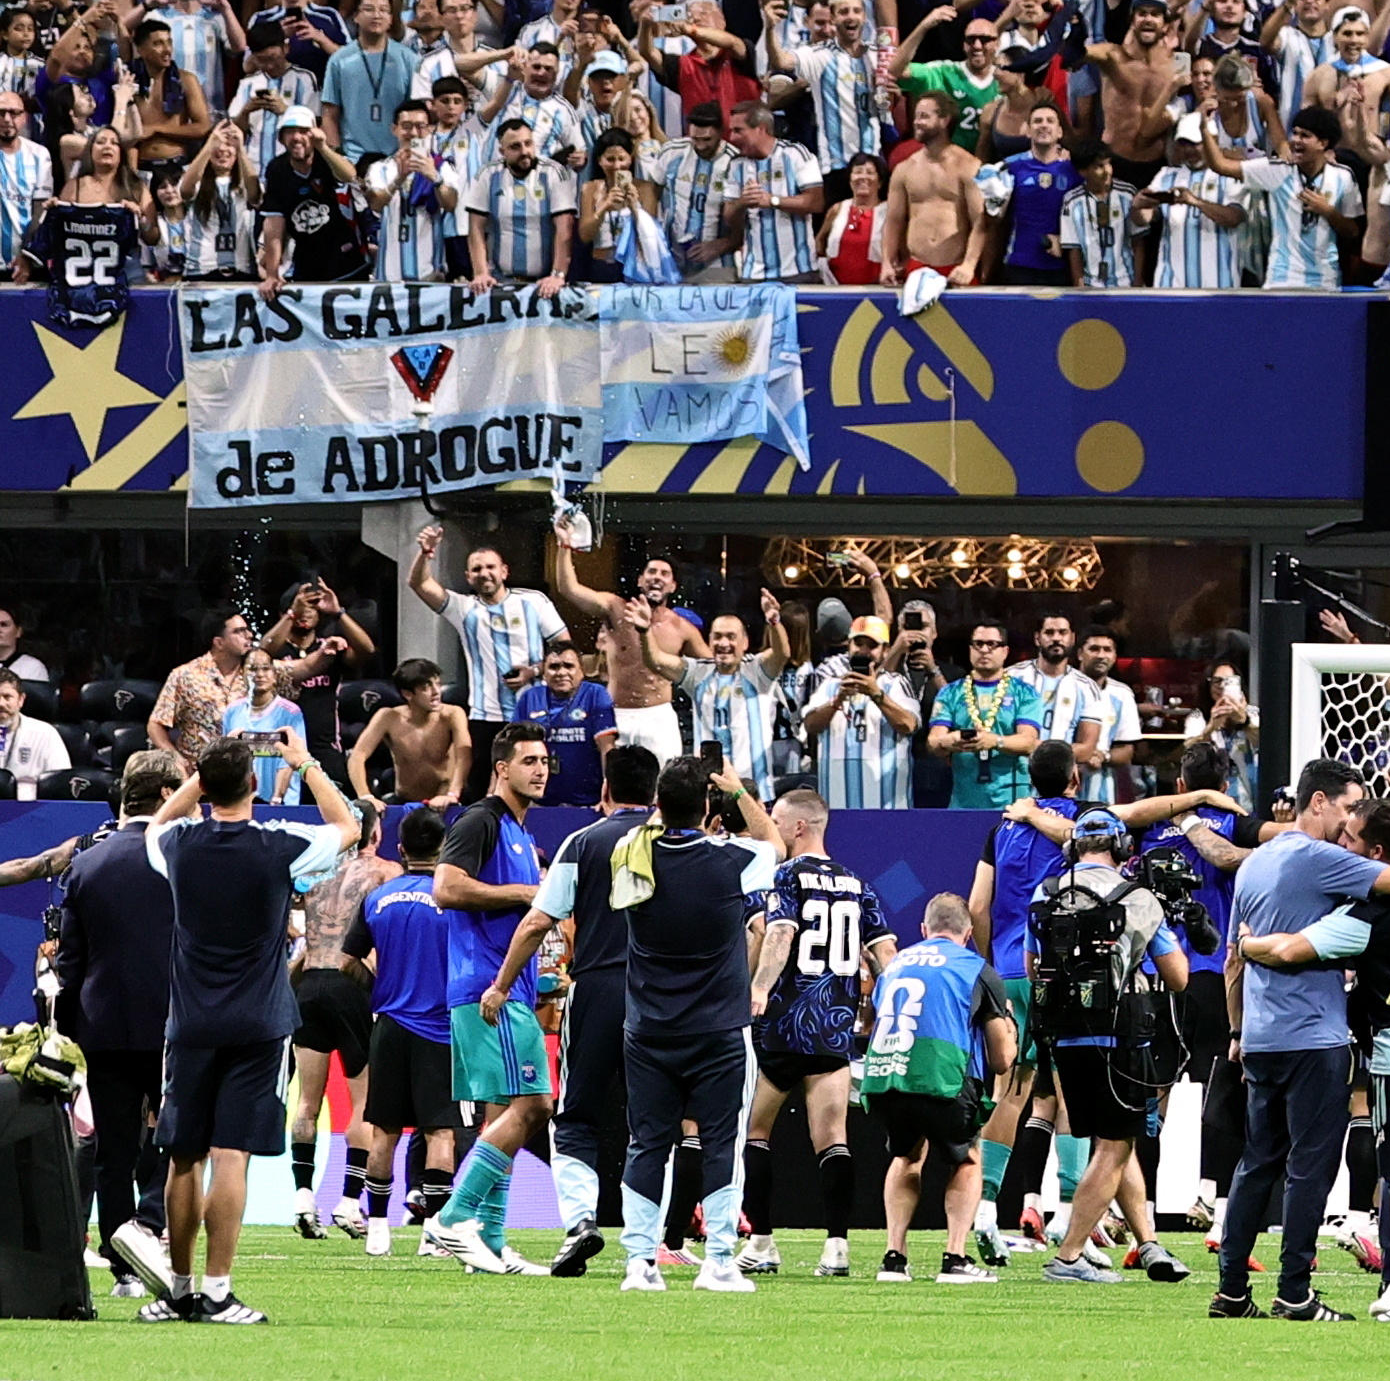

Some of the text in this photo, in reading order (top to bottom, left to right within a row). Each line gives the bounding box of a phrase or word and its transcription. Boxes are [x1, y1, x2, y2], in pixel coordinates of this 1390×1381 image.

[690, 192, 707, 214] 10
[1099, 225, 1115, 248] 10
[65, 238, 117, 286] 22
[187, 288, 303, 352] LAS
[649, 332, 708, 375] LE
[634, 384, 761, 433] VAMOS
[216, 439, 296, 498] de
[322, 413, 583, 494] ADROGUE
[797, 899, 862, 977] 20
